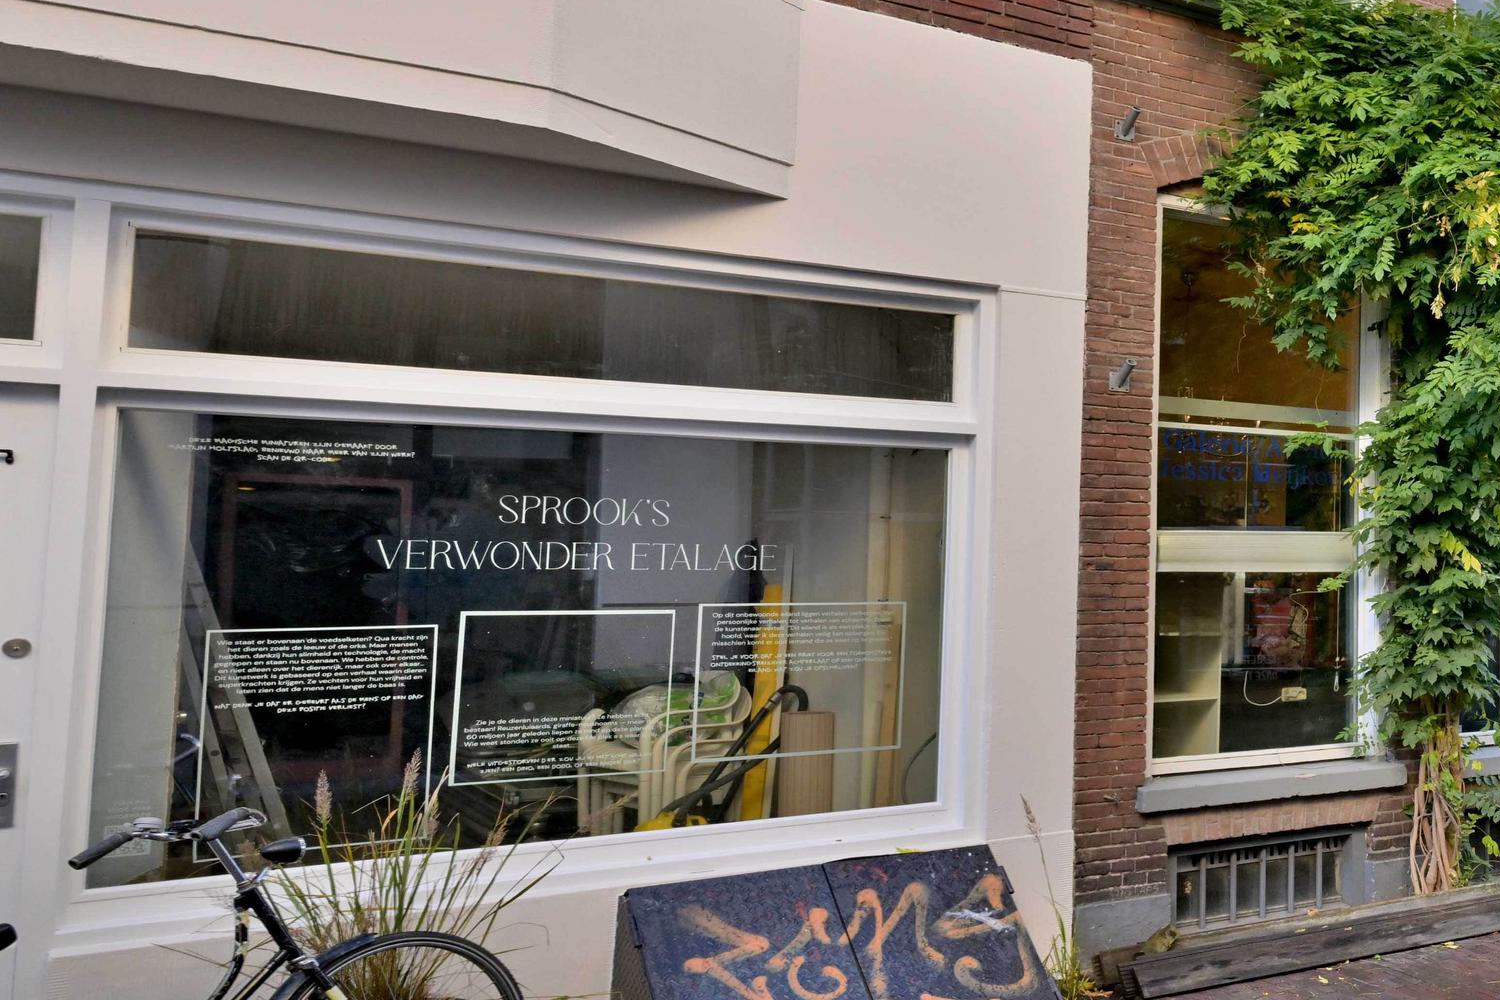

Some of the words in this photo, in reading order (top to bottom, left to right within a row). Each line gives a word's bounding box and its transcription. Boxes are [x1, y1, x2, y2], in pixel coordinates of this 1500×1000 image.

[498, 494, 670, 526] SPROOK'S
[376, 539, 616, 571] VERWONDER
[630, 542, 778, 572] ETALAGE
[318, 635, 373, 643] voedselketen?
[416, 633, 428, 641] zijn
[253, 651, 281, 660] dankzij
[278, 670, 320, 679] gebaseerd
[218, 679, 277, 688] superkrachten
[385, 674, 412, 682] vrijheid
[342, 682, 366, 690] langer
[478, 732, 505, 741] miljoen
[506, 731, 520, 740] jaar
[522, 730, 550, 739] geleden
[551, 729, 573, 737] liepen
